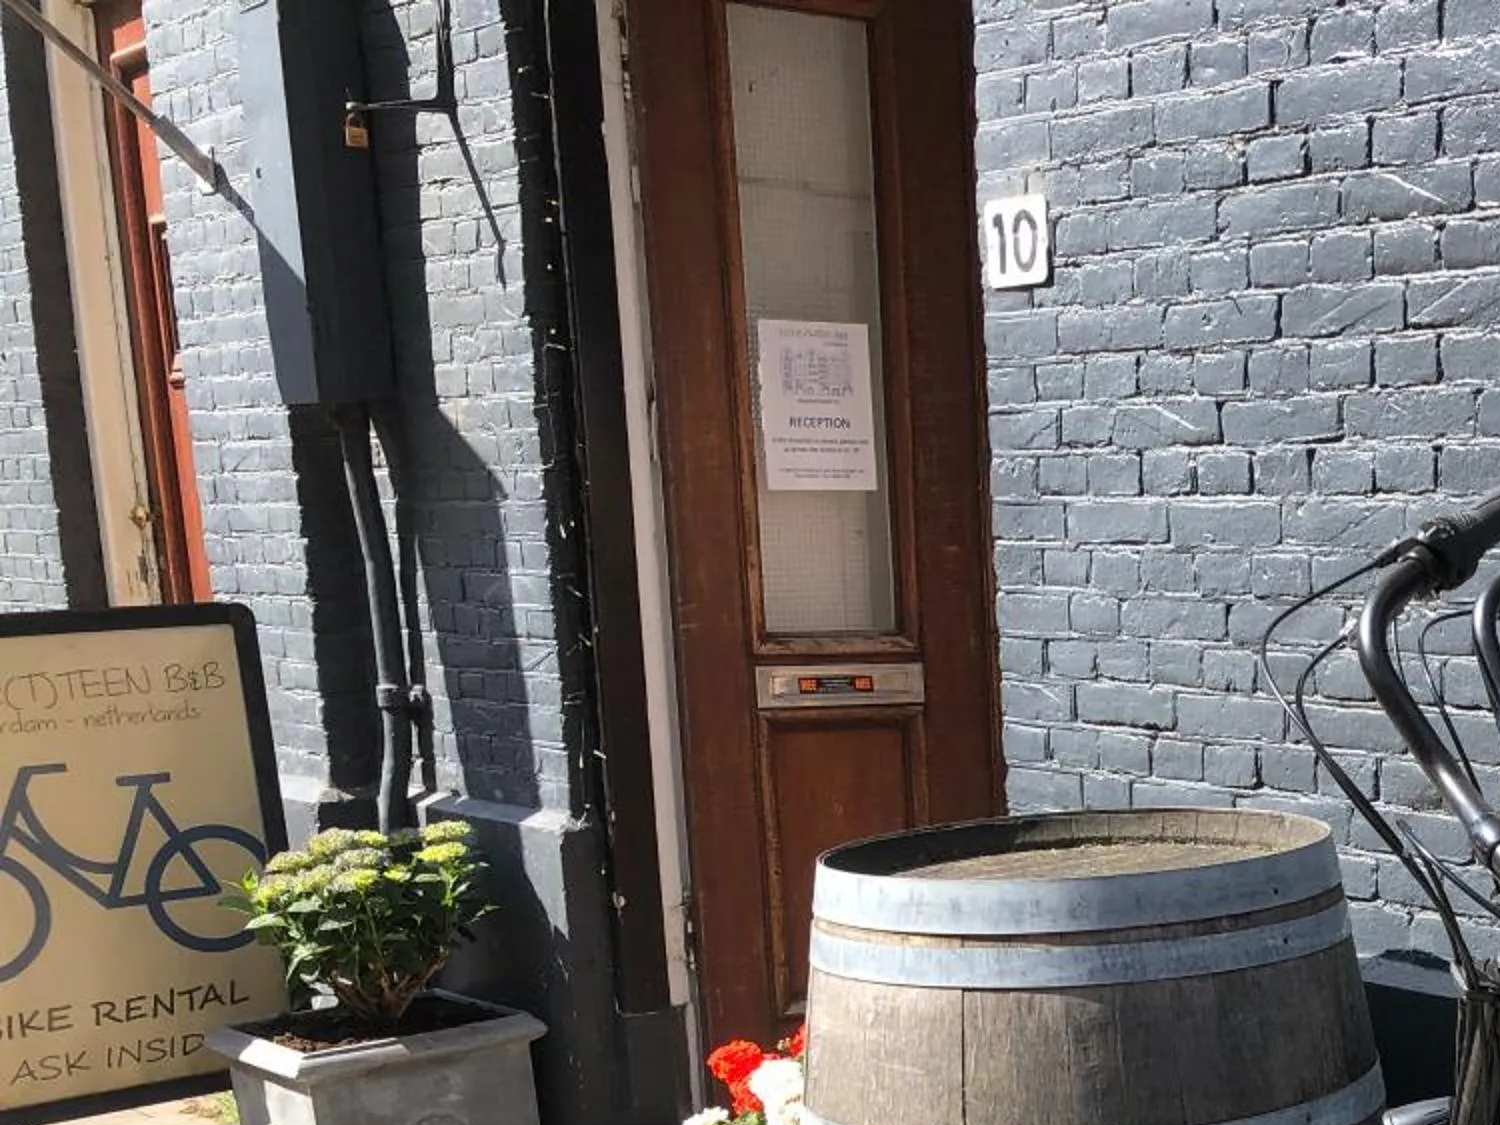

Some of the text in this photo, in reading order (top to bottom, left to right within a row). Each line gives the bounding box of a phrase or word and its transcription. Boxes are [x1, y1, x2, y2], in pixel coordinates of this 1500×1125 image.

[992, 208, 1038, 275] 10
[788, 416, 851, 430] RECEPTION
[0, 661, 225, 712] (T)TEEN B&B
[0, 979, 250, 1041] IKE RENTAL
[10, 1033, 206, 1086] ASK INSID
